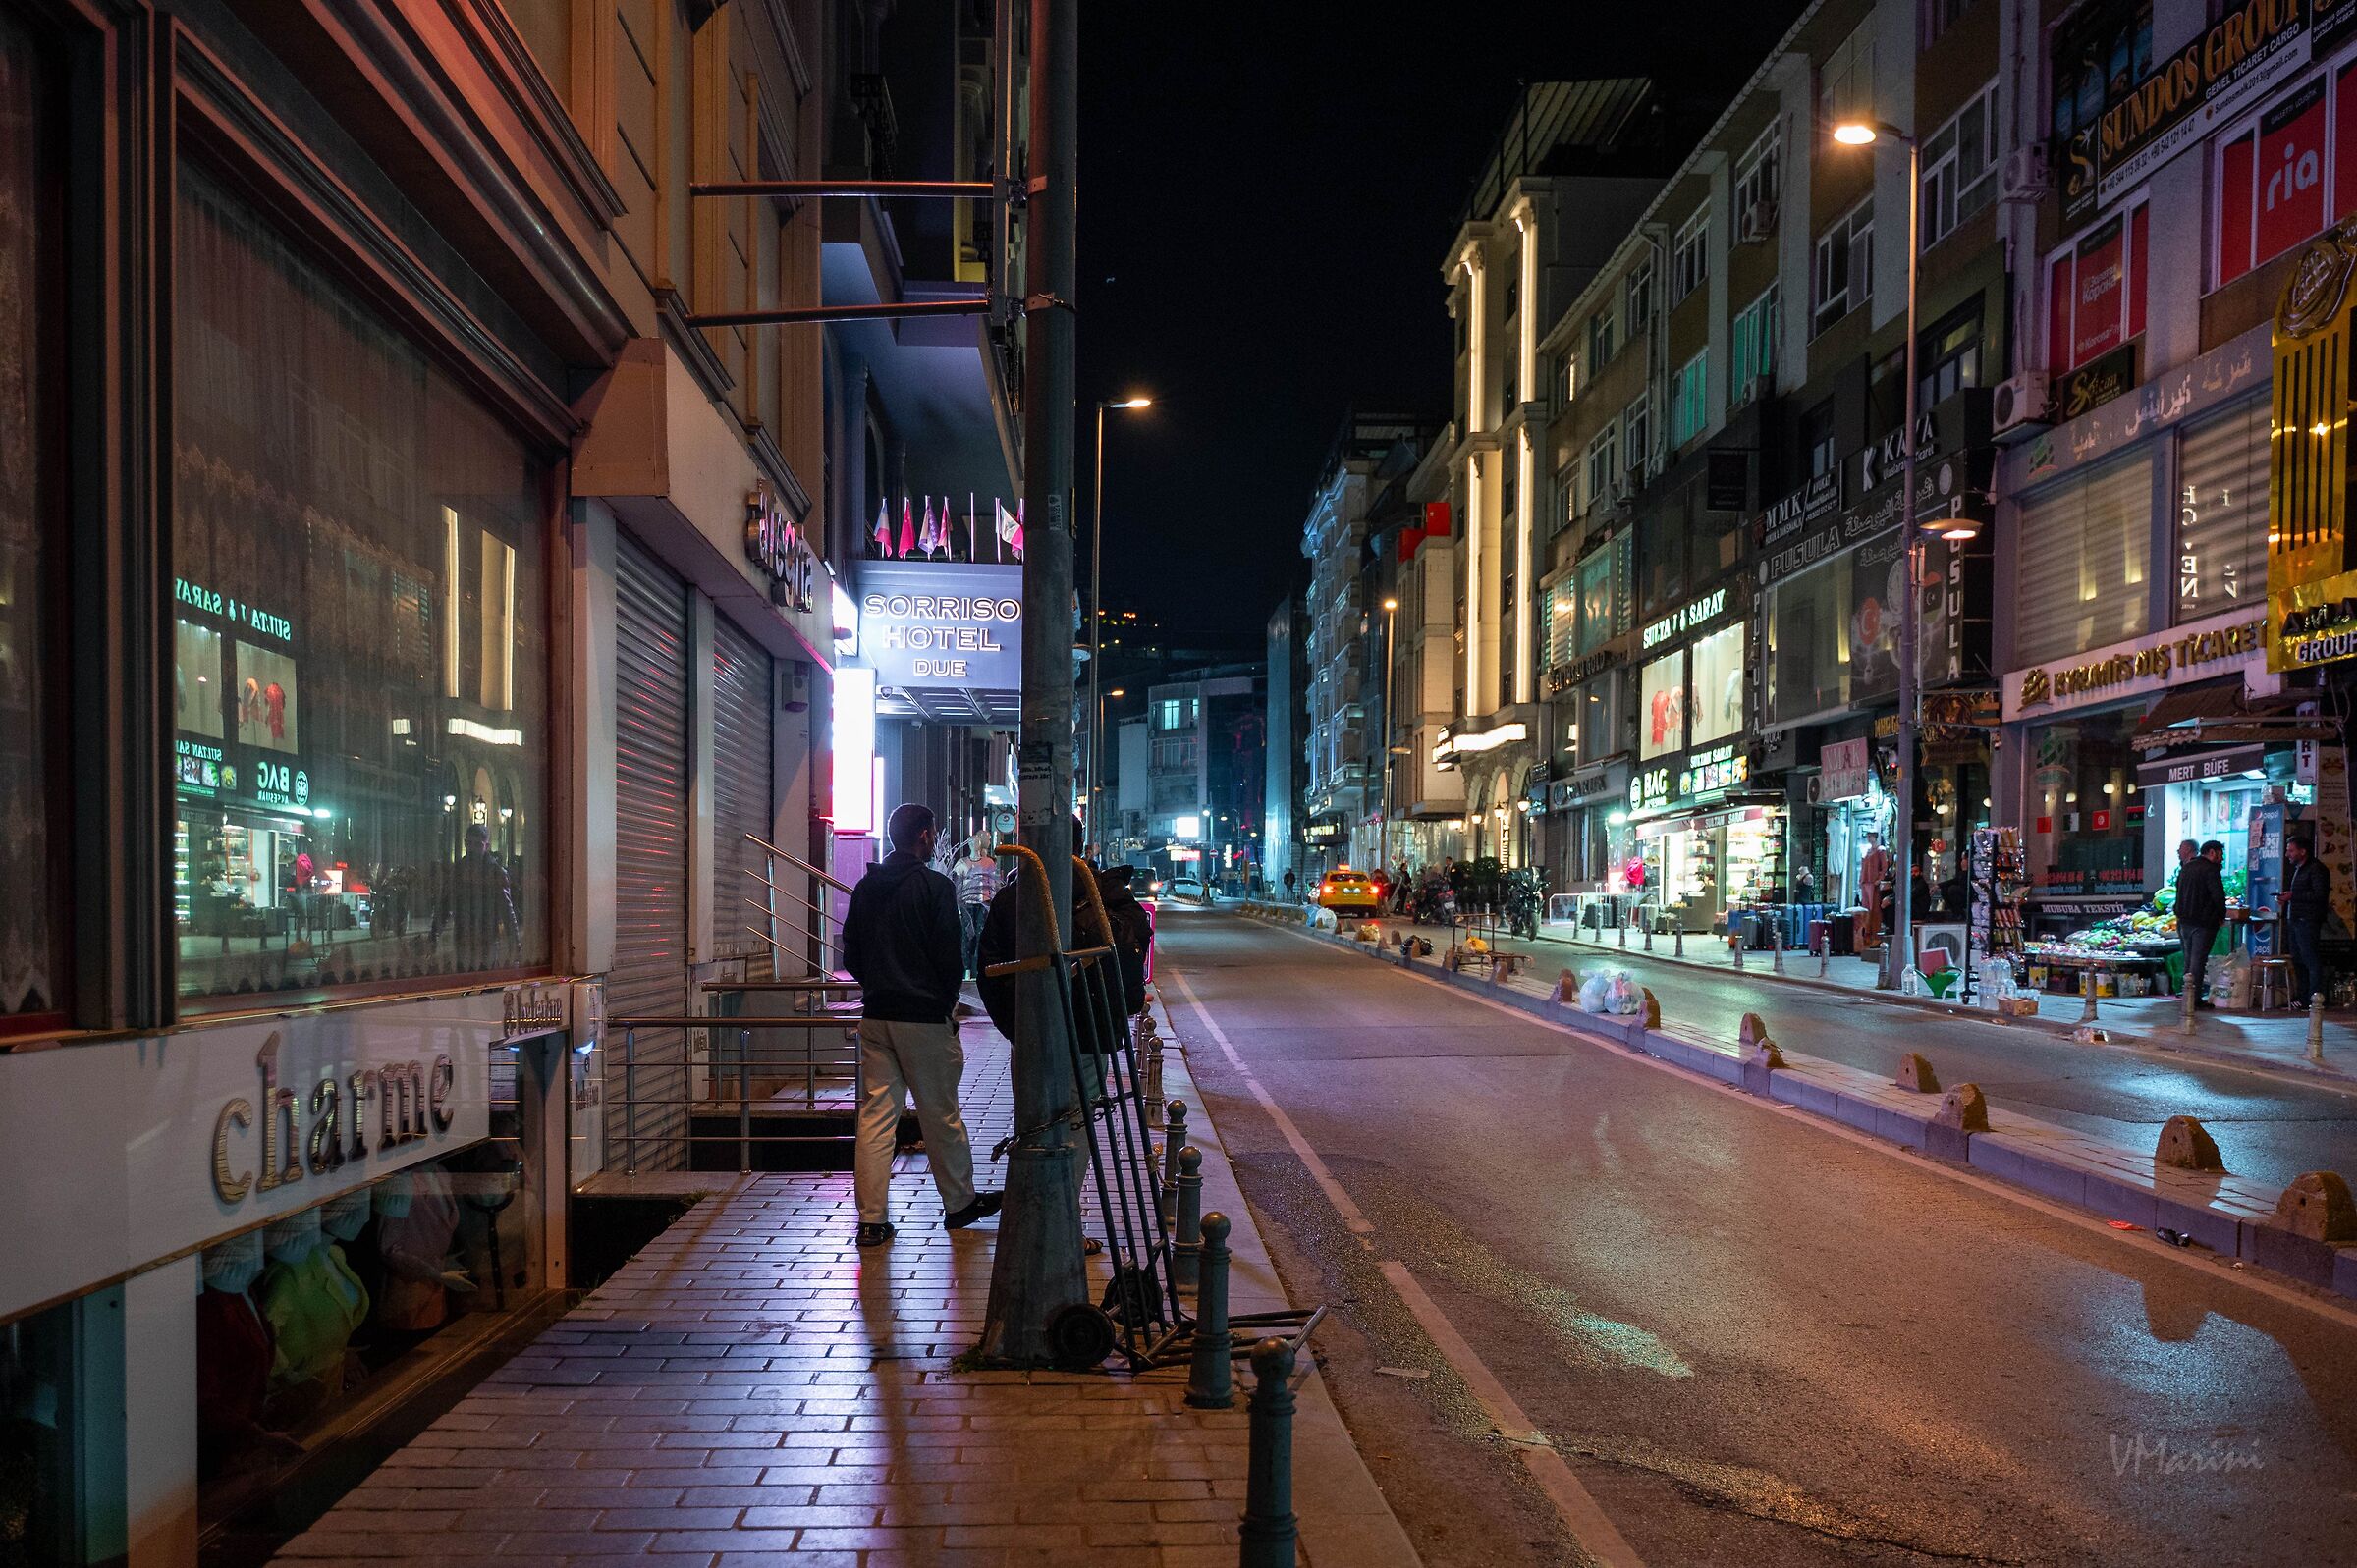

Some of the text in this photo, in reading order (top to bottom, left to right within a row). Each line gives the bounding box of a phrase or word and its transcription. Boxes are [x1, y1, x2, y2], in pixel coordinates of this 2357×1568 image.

[2205, 22, 2300, 100] GENEL TİCARET CARGO
[2101, 45, 2199, 162] SUNDOS
[2266, 142, 2319, 212] ria
[1766, 491, 1802, 532] MMK
[1771, 525, 1841, 579] PUSULA
[863, 594, 1021, 622] SORRISO
[1688, 588, 1726, 626] SARAY
[882, 625, 1004, 652] HOTEL
[913, 658, 970, 677] DUE
[1712, 744, 1733, 763] SARAY
[2168, 758, 2229, 783] MERT BÜFE
[1644, 767, 1669, 798] BAG
[2083, 901, 2127, 914] TEKSTİL
[212, 1031, 455, 1205] charme
